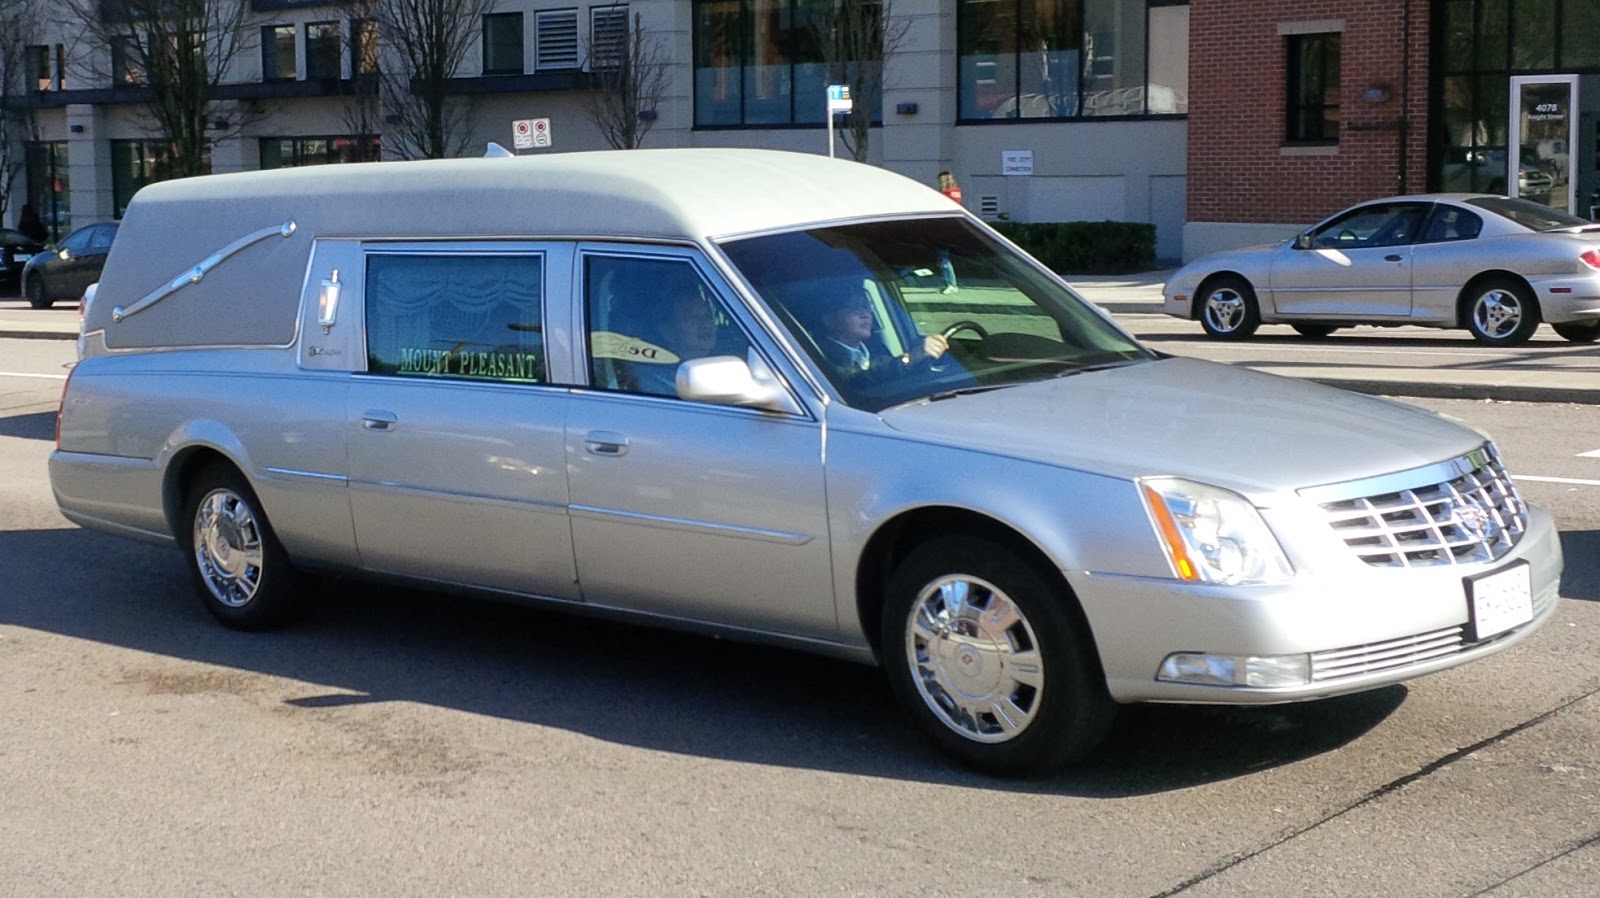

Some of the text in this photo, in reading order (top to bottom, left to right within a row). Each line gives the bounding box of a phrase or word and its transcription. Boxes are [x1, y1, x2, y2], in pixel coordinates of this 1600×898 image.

[1535, 103, 1557, 112] 4078
[400, 349, 536, 378] MOUNT PLEASANT
